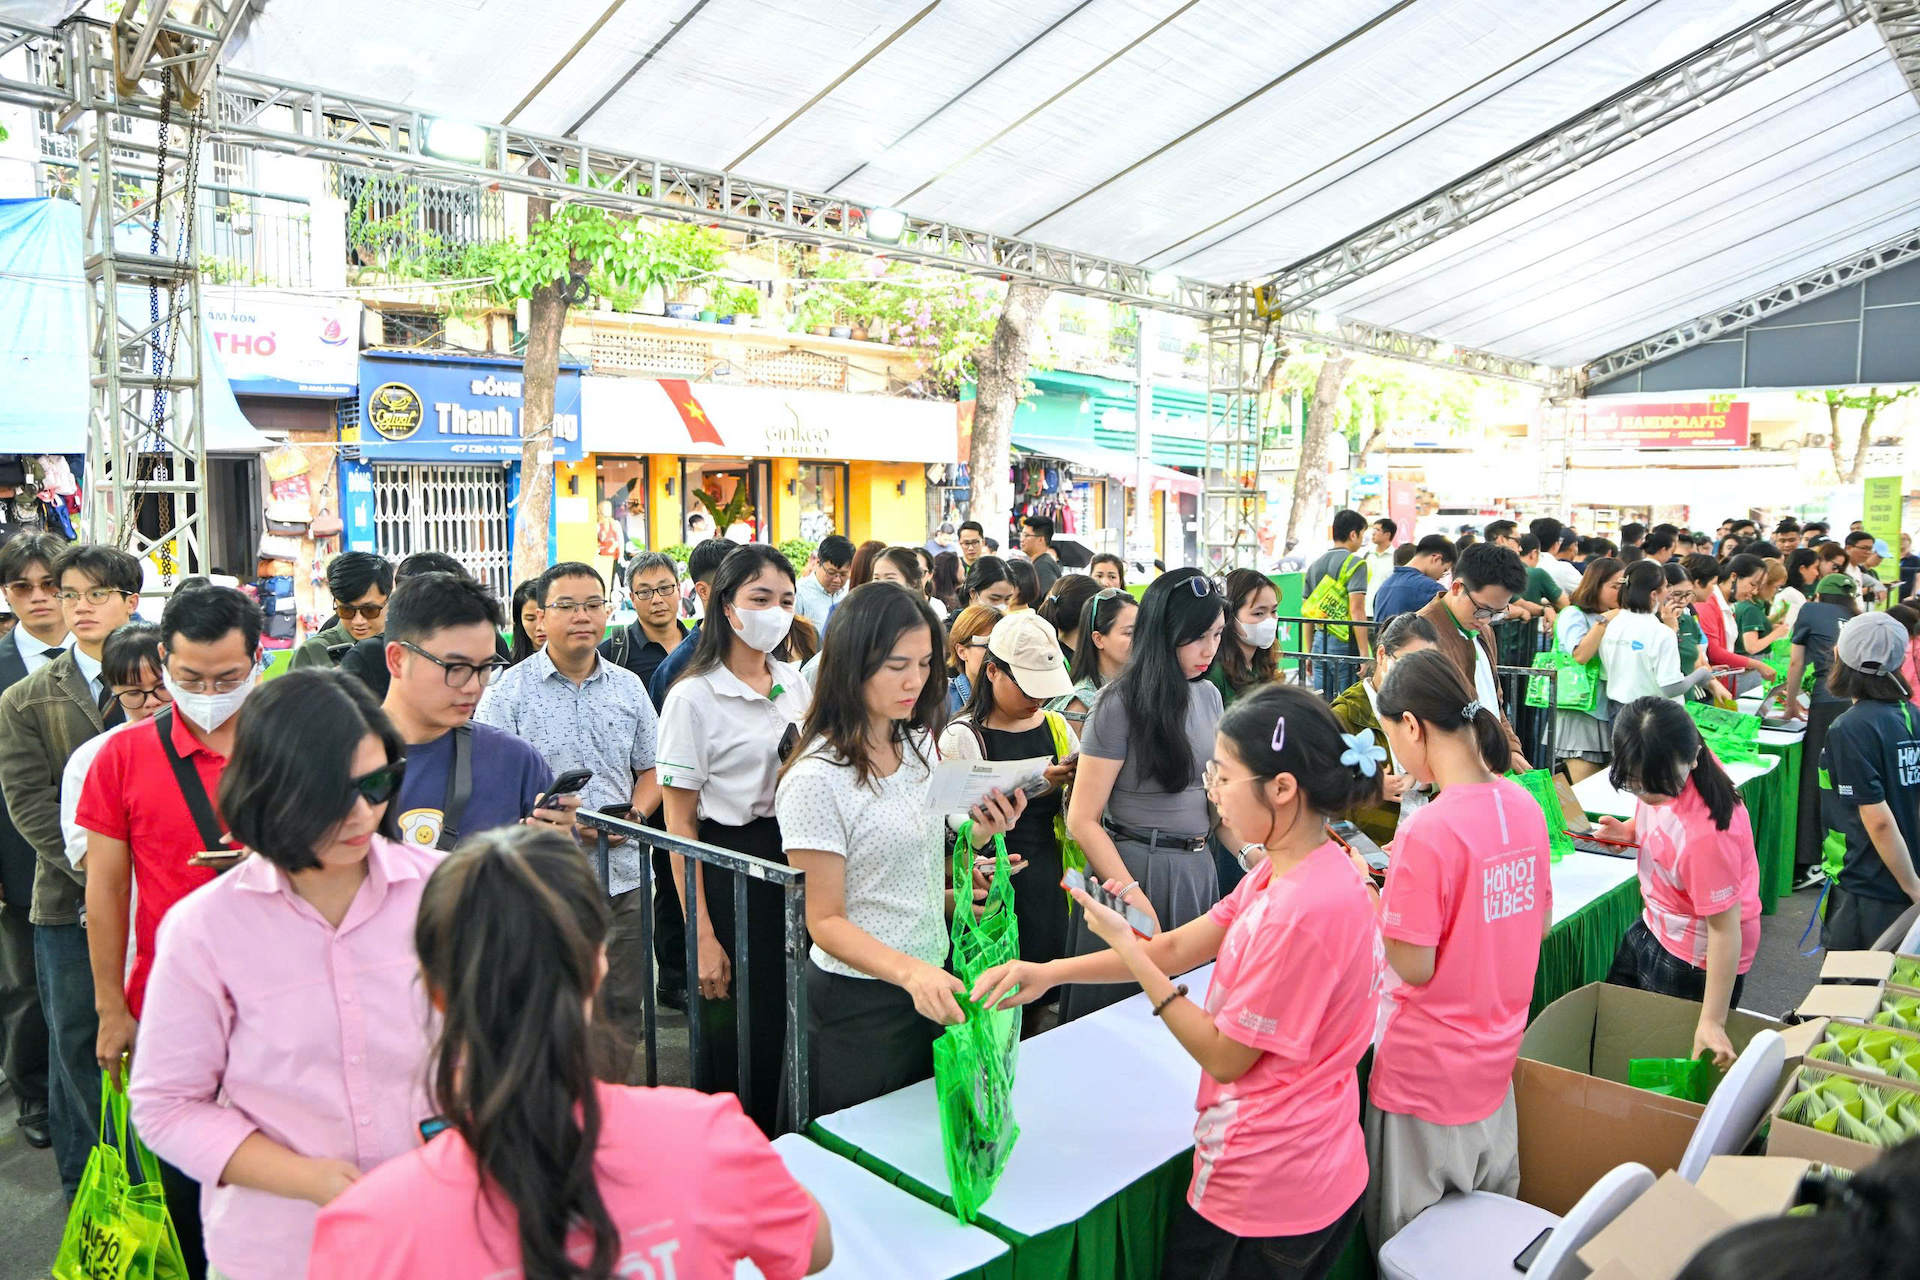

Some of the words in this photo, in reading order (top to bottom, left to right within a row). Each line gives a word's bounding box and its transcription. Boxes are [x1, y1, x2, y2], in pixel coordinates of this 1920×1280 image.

[231, 314, 256, 324] NON
[435, 402, 513, 436] Thanh
[1621, 415, 1726, 430] HANDICRAFTS
[450, 444, 468, 454] 47
